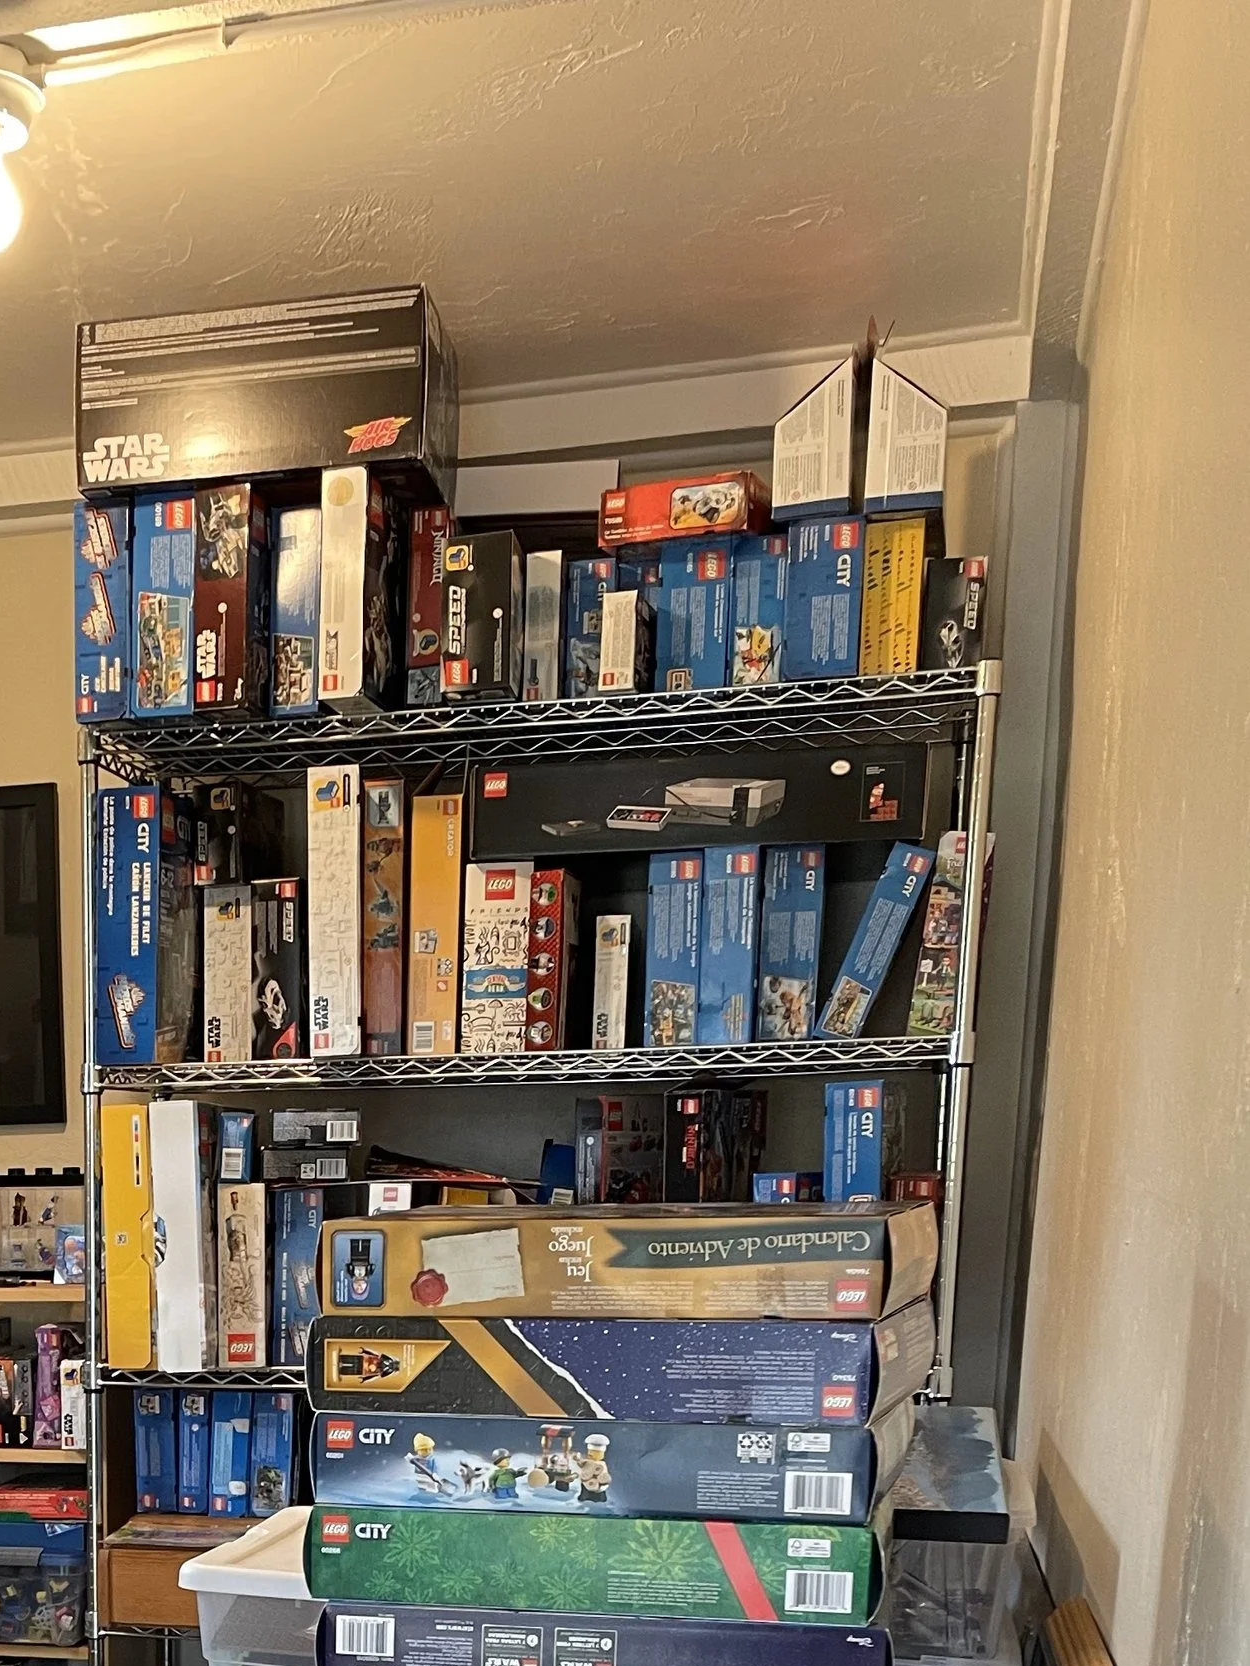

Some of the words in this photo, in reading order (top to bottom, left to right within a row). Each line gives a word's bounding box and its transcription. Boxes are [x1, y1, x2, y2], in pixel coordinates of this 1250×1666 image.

[362, 417, 395, 435] AIR
[83, 433, 169, 457] STAR
[348, 430, 399, 454] HOGS
[83, 453, 169, 482] WARS
[606, 498, 626, 509] LEGO
[174, 503, 184, 527] LEGO
[842, 525, 851, 548] LEGO
[430, 530, 445, 586] NINJAGO
[706, 553, 718, 579] LEGO
[838, 554, 851, 587] CITY
[967, 582, 979, 629] SPEED
[449, 585, 461, 655] SPEED
[196, 630, 207, 675] STAR
[204, 629, 216, 678] WARS
[452, 661, 462, 683] LEGO
[80, 674, 90, 695] CITY
[485, 779, 507, 790] LEGO
[140, 797, 149, 817] LEGO
[138, 823, 149, 853] CITY
[446, 818, 454, 857] CREATOR
[143, 862, 151, 901] LANCEUR
[488, 878, 514, 891] LEGO
[806, 871, 815, 891] CITY
[903, 876, 917, 897] CITY
[314, 996, 323, 1031] STAR
[320, 998, 329, 1031] WARS
[861, 1112, 873, 1138] CITY
[307, 1210, 316, 1228] CITY
[549, 1236, 594, 1258] Juego
[649, 1240, 735, 1262] Adviento
[737, 1236, 761, 1258] de
[764, 1231, 871, 1254] Calendario
[567, 1261, 592, 1282] Jeu
[837, 1290, 867, 1304] LEGO
[231, 1344, 253, 1353] LEGO
[823, 1396, 853, 1408] LEGO
[328, 1429, 352, 1441] LEGO
[358, 1428, 395, 1445] CITY
[324, 1524, 347, 1536] LEGO
[354, 1523, 392, 1539] CITY
